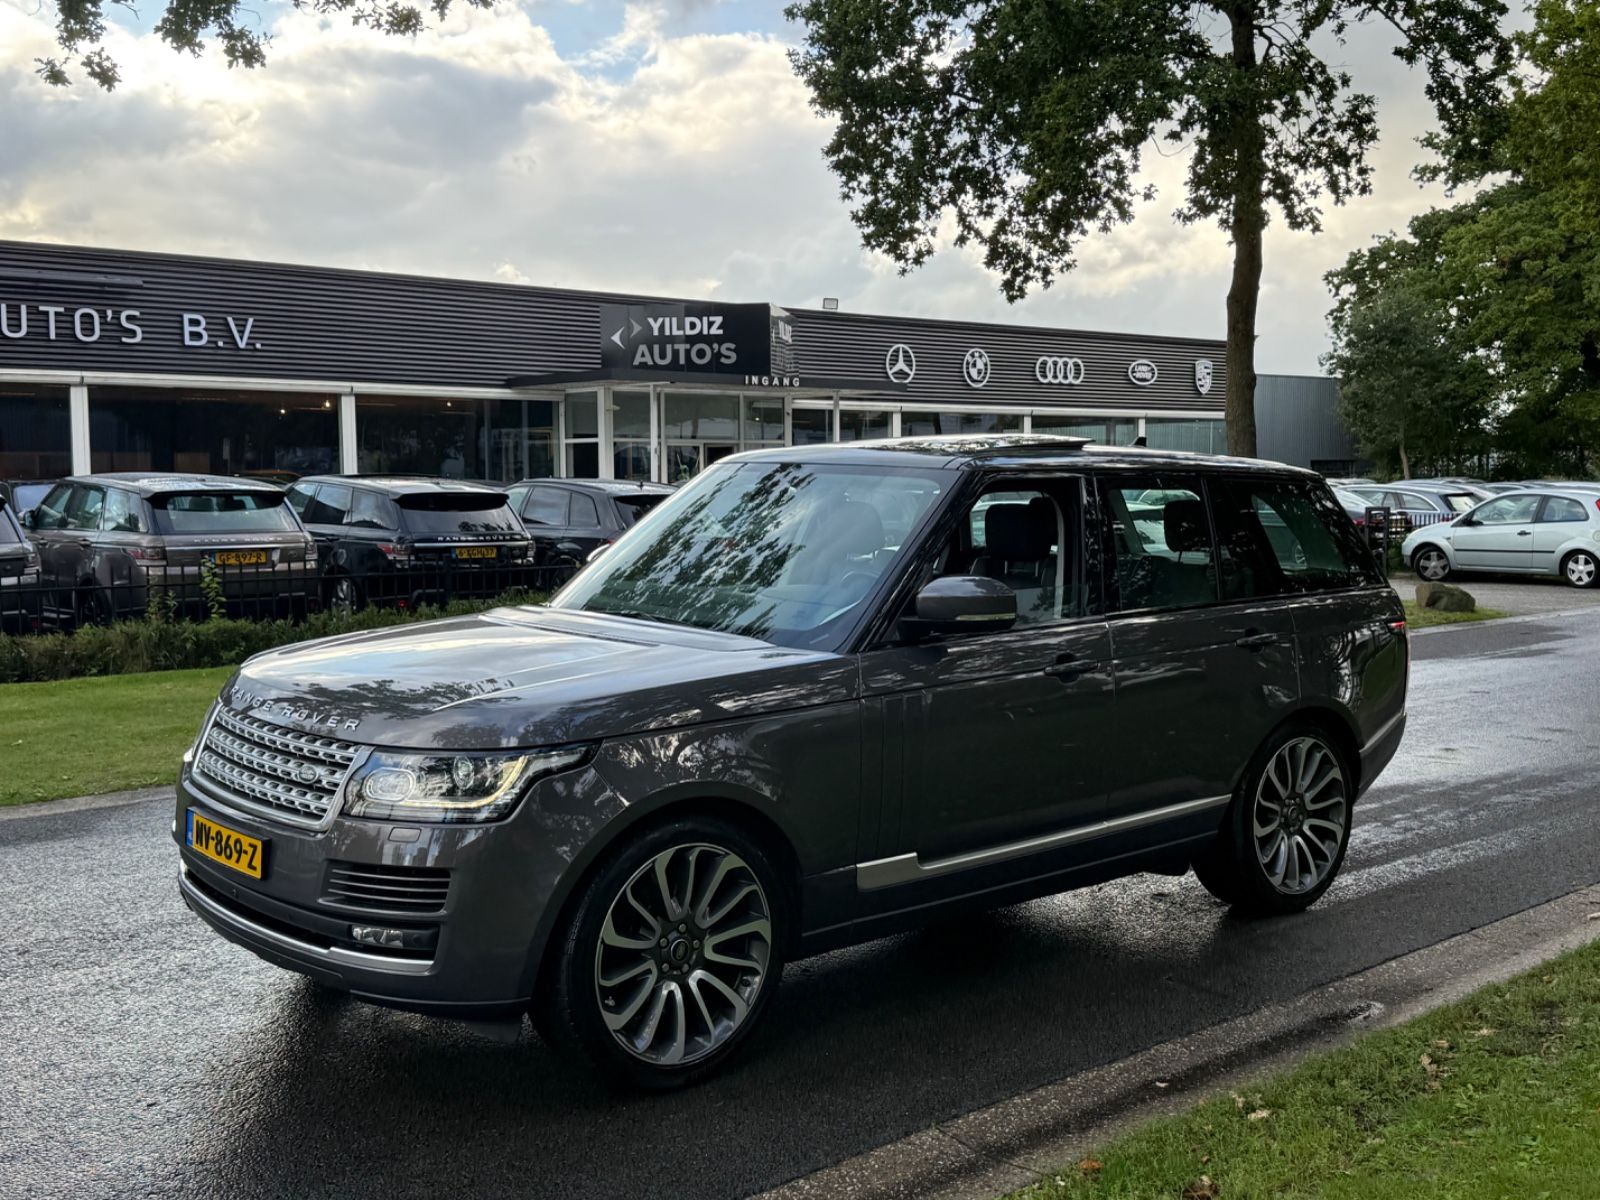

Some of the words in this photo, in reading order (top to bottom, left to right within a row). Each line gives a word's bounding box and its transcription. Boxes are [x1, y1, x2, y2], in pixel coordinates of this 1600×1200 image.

[182, 313, 262, 349] B.V.
[647, 316, 724, 336] YILDIZ
[633, 343, 737, 366] AUTO'S
[745, 375, 800, 387] INGANG
[229, 685, 274, 711] RANGE
[281, 706, 359, 731] ROVER
[195, 820, 257, 872] NV-869-Z
